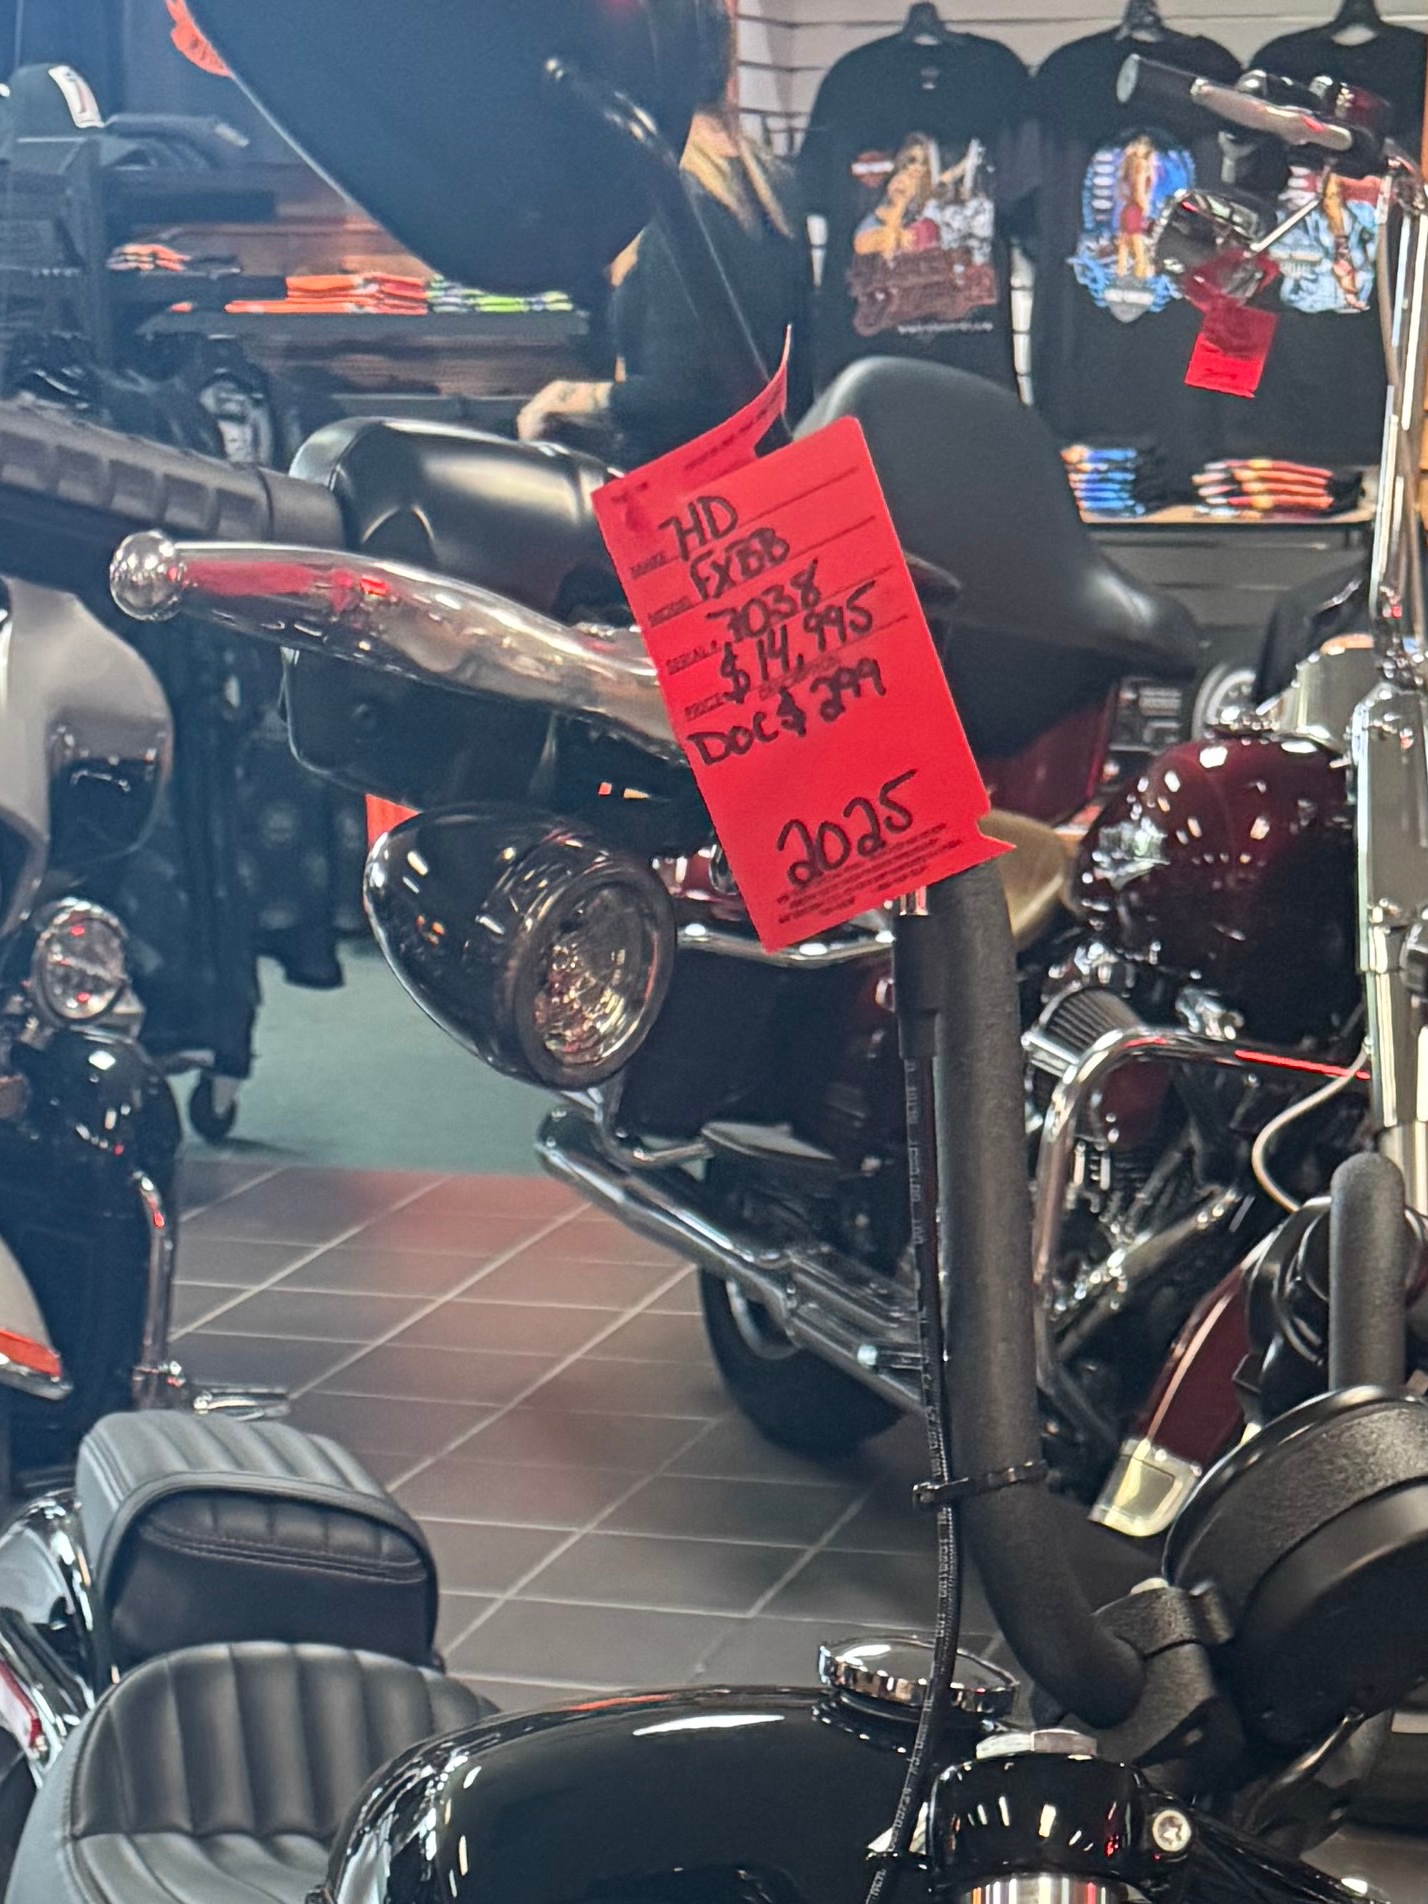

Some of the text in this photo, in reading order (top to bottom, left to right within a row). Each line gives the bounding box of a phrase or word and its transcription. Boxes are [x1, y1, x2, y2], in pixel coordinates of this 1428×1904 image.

[658, 496, 738, 561] HD
[689, 527, 790, 601] FXBB
[777, 769, 917, 887] 2025
